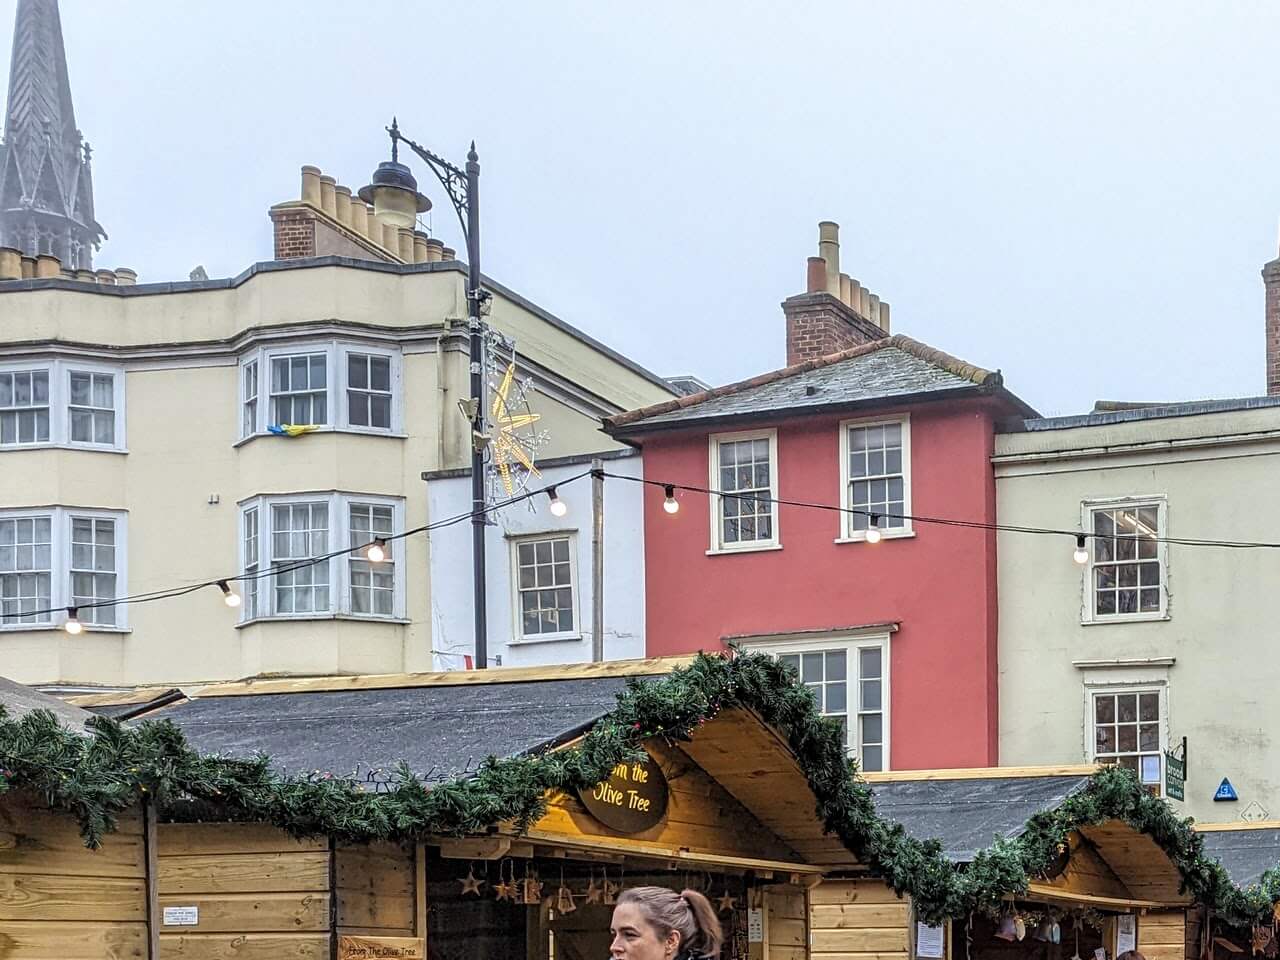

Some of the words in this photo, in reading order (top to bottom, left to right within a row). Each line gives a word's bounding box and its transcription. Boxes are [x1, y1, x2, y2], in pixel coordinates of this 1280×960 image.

[632, 763, 649, 783] the
[593, 781, 624, 806] Olive
[627, 790, 651, 812] Tree
[369, 946, 381, 956] The
[382, 946, 399, 956] Olive
[400, 947, 416, 956] Tree
